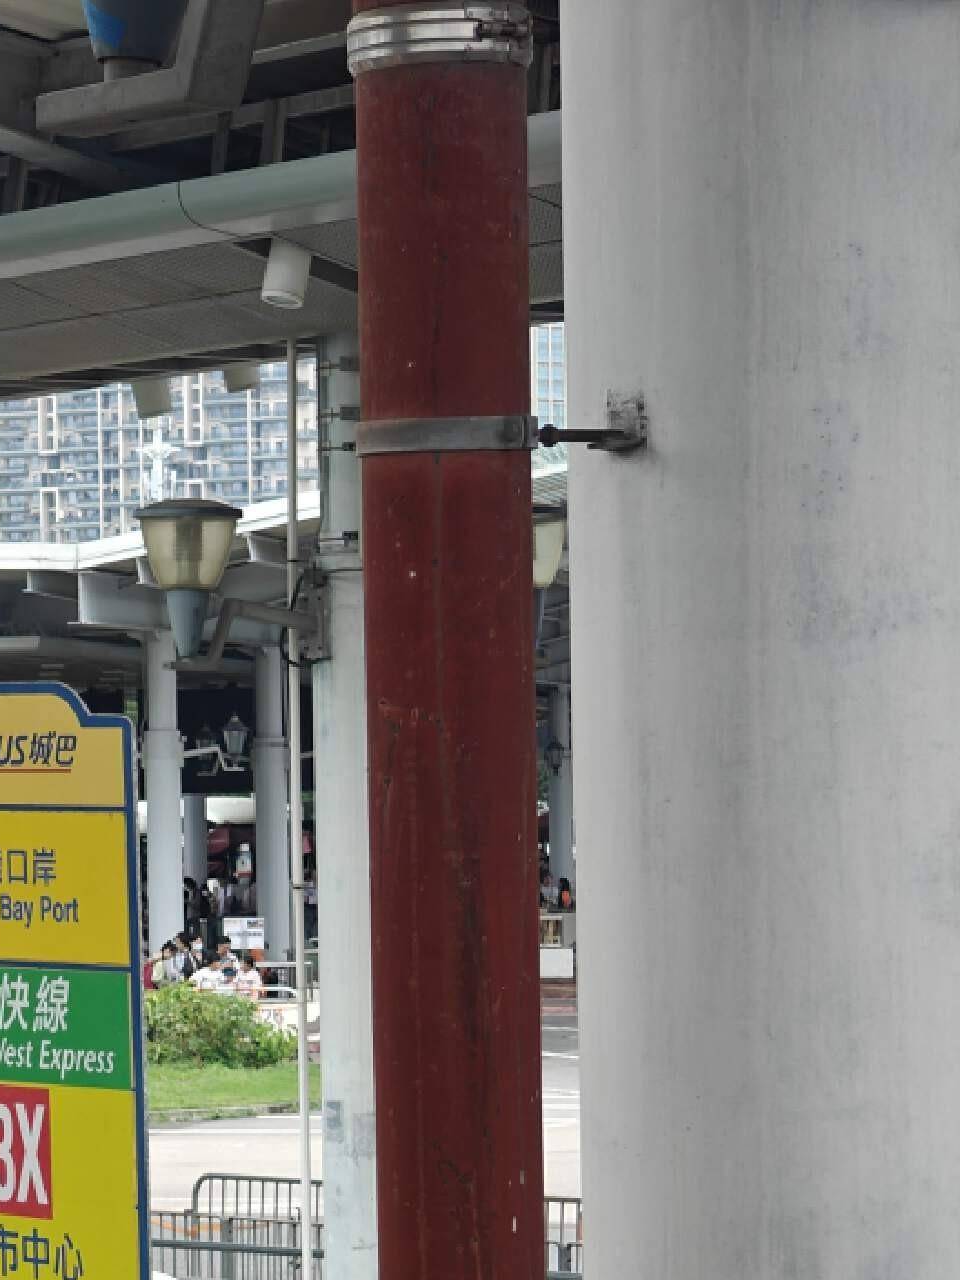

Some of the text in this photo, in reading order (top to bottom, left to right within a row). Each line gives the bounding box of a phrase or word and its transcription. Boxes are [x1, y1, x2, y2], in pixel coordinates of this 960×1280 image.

[0, 893, 34, 927] Bay
[40, 896, 79, 923] Port
[40, 1039, 116, 1079] Express
